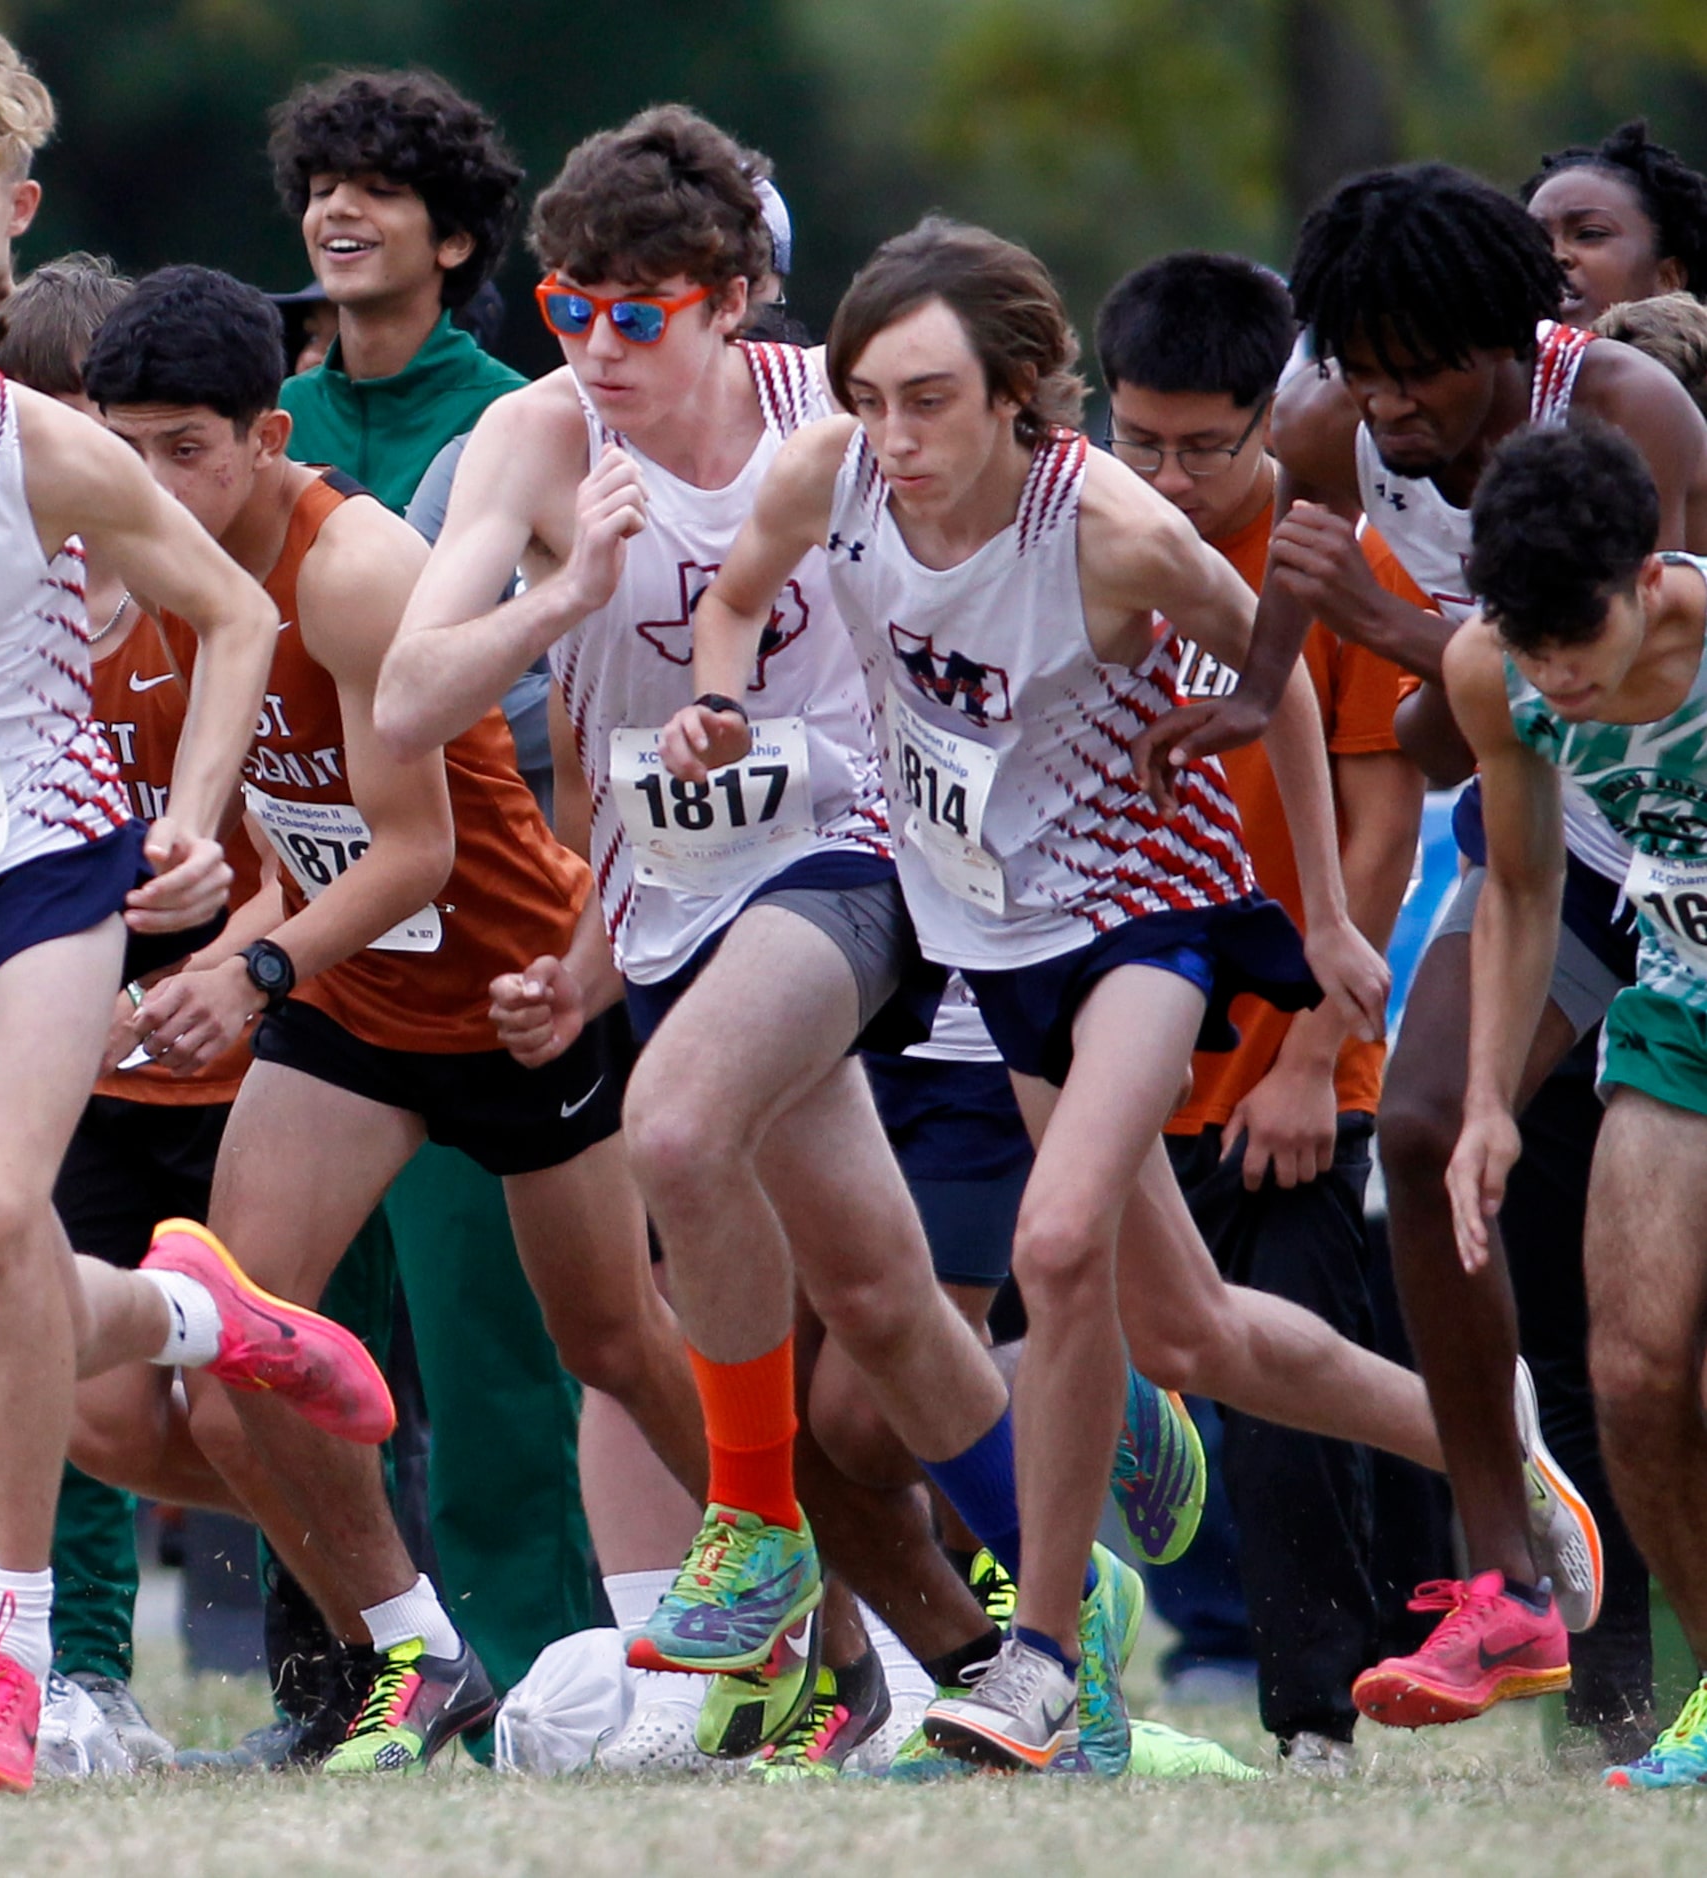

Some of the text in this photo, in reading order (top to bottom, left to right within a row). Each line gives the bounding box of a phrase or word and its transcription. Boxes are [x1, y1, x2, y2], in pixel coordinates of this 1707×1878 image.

[634, 764, 789, 831] 1817
[287, 805, 326, 819] Region
[331, 809, 341, 820] II
[277, 816, 364, 836] Championship
